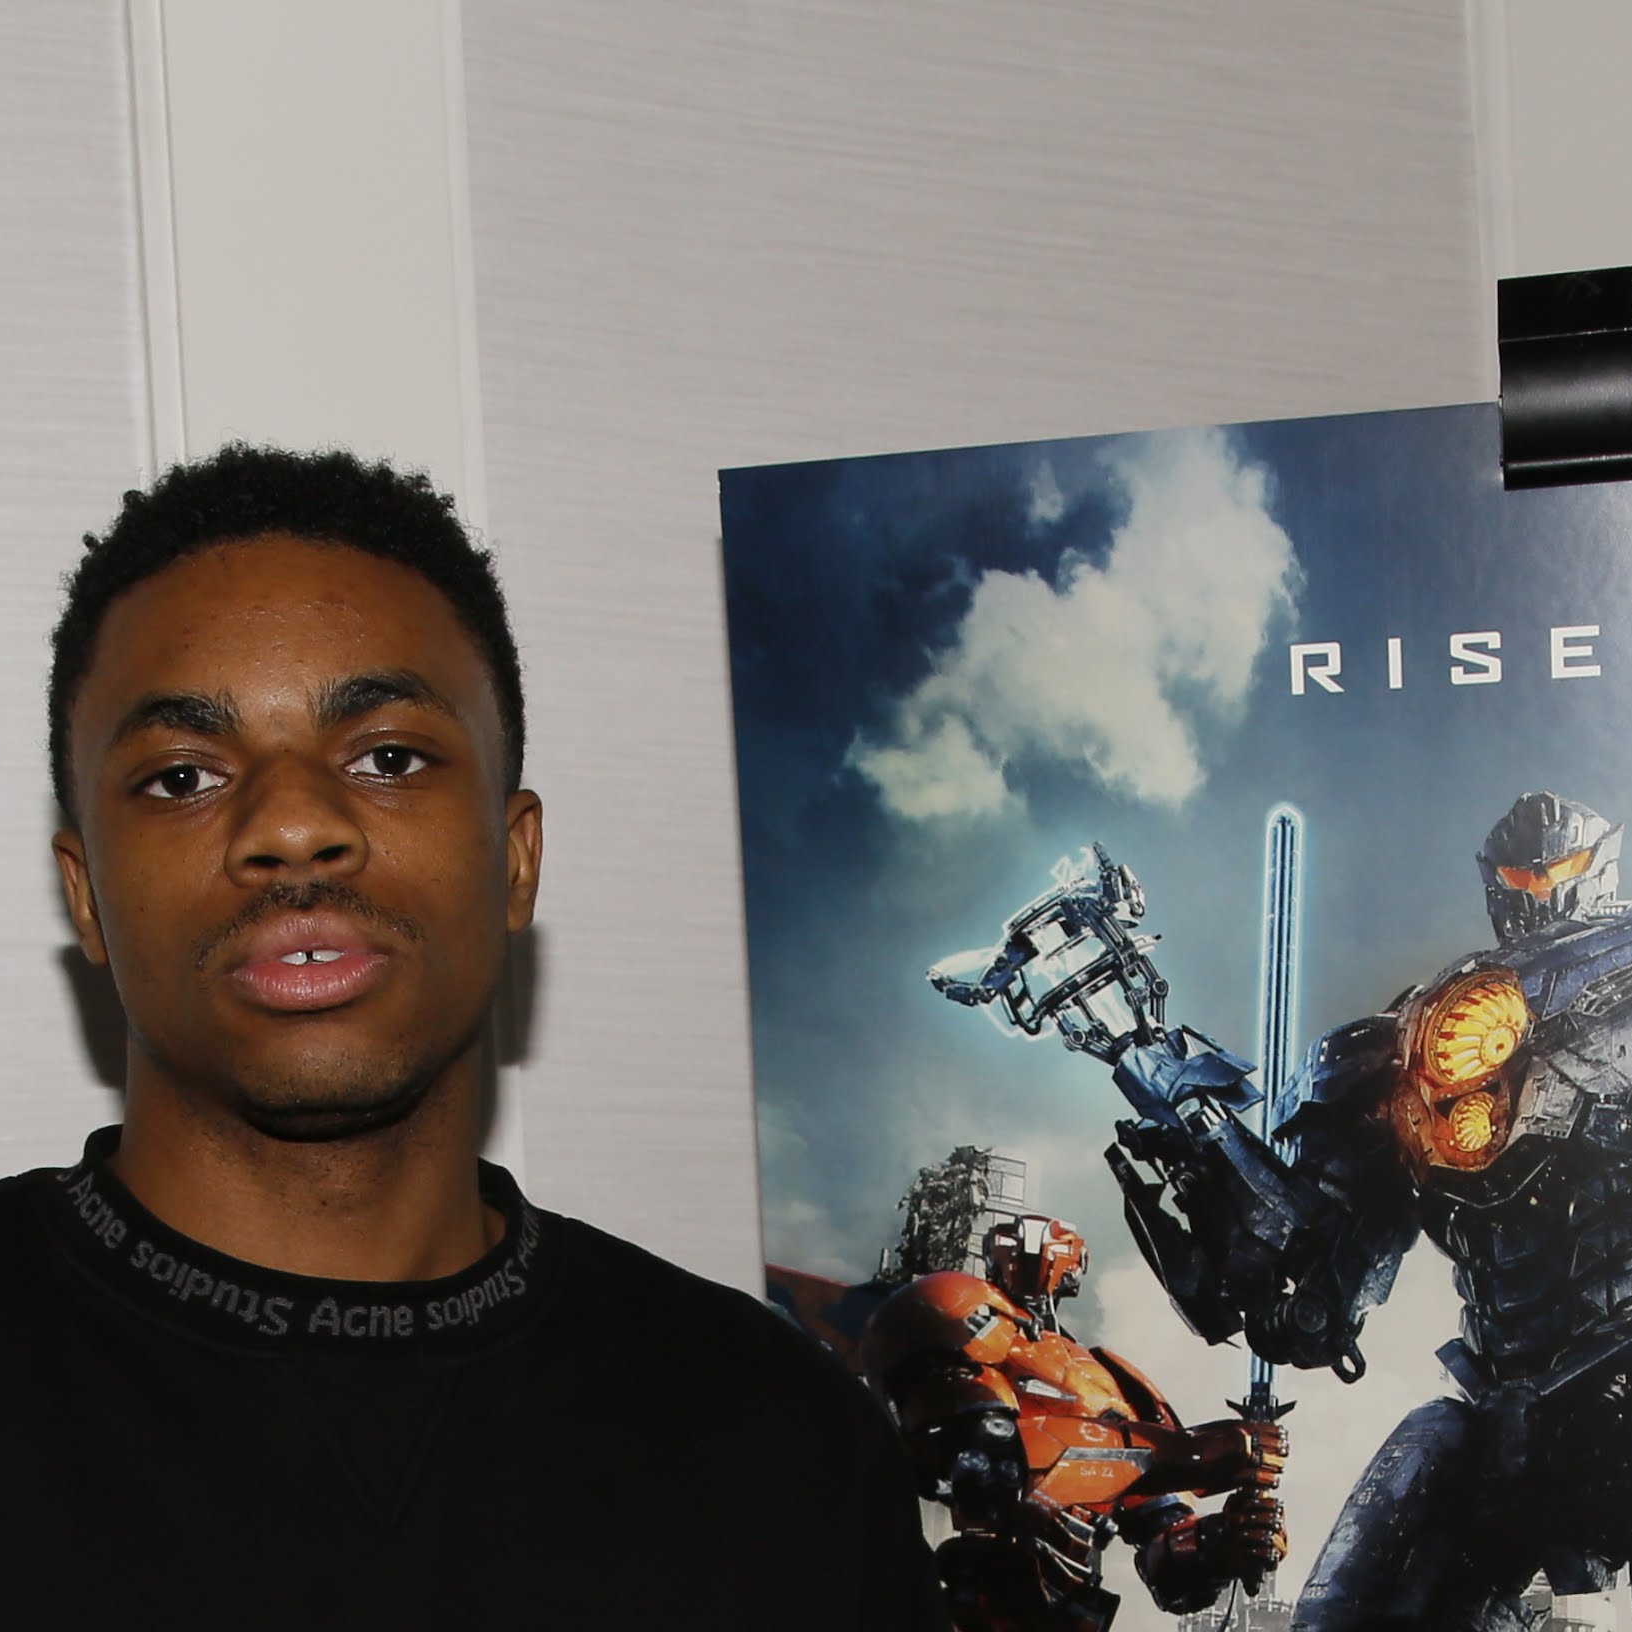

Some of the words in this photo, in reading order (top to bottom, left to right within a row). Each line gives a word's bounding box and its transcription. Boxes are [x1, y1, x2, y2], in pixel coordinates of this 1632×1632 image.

[1290, 625, 1602, 695] RISE
[66, 1170, 128, 1249] Acne
[307, 1296, 415, 1338] Acne
